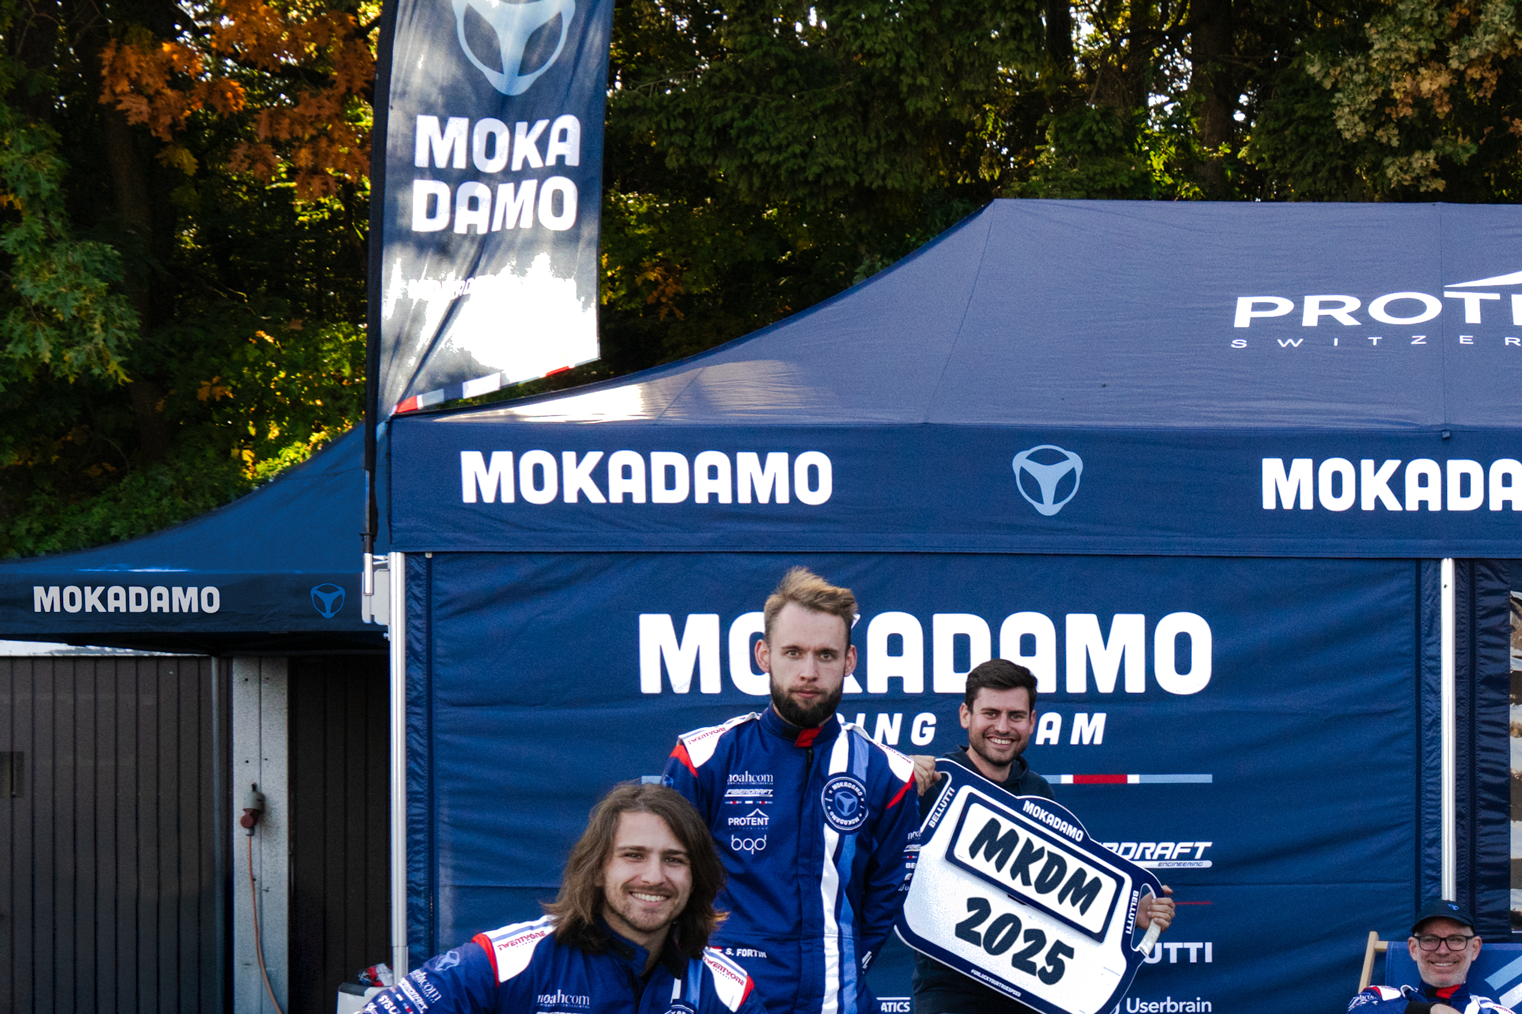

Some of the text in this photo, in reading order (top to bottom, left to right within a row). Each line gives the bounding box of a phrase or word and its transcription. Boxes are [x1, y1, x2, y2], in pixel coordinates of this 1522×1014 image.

[415, 115, 581, 173] MOKA
[411, 177, 578, 234] DAMO
[460, 450, 833, 505] MOKADAMO
[34, 585, 221, 613] MOKADAMO
[639, 611, 1213, 694] MOADAMO
[728, 817, 769, 826] PROTENT
[928, 787, 955, 828] BELLUTTI
[1023, 800, 1084, 842] MOKADAMO
[969, 817, 1102, 916] MKDM
[1125, 890, 1139, 935] BELLUTTI
[955, 897, 1074, 985] 2025
[537, 989, 590, 1006] noahcom
[880, 1002, 911, 1013] ATICS
[1126, 996, 1213, 1013] Userbrain
